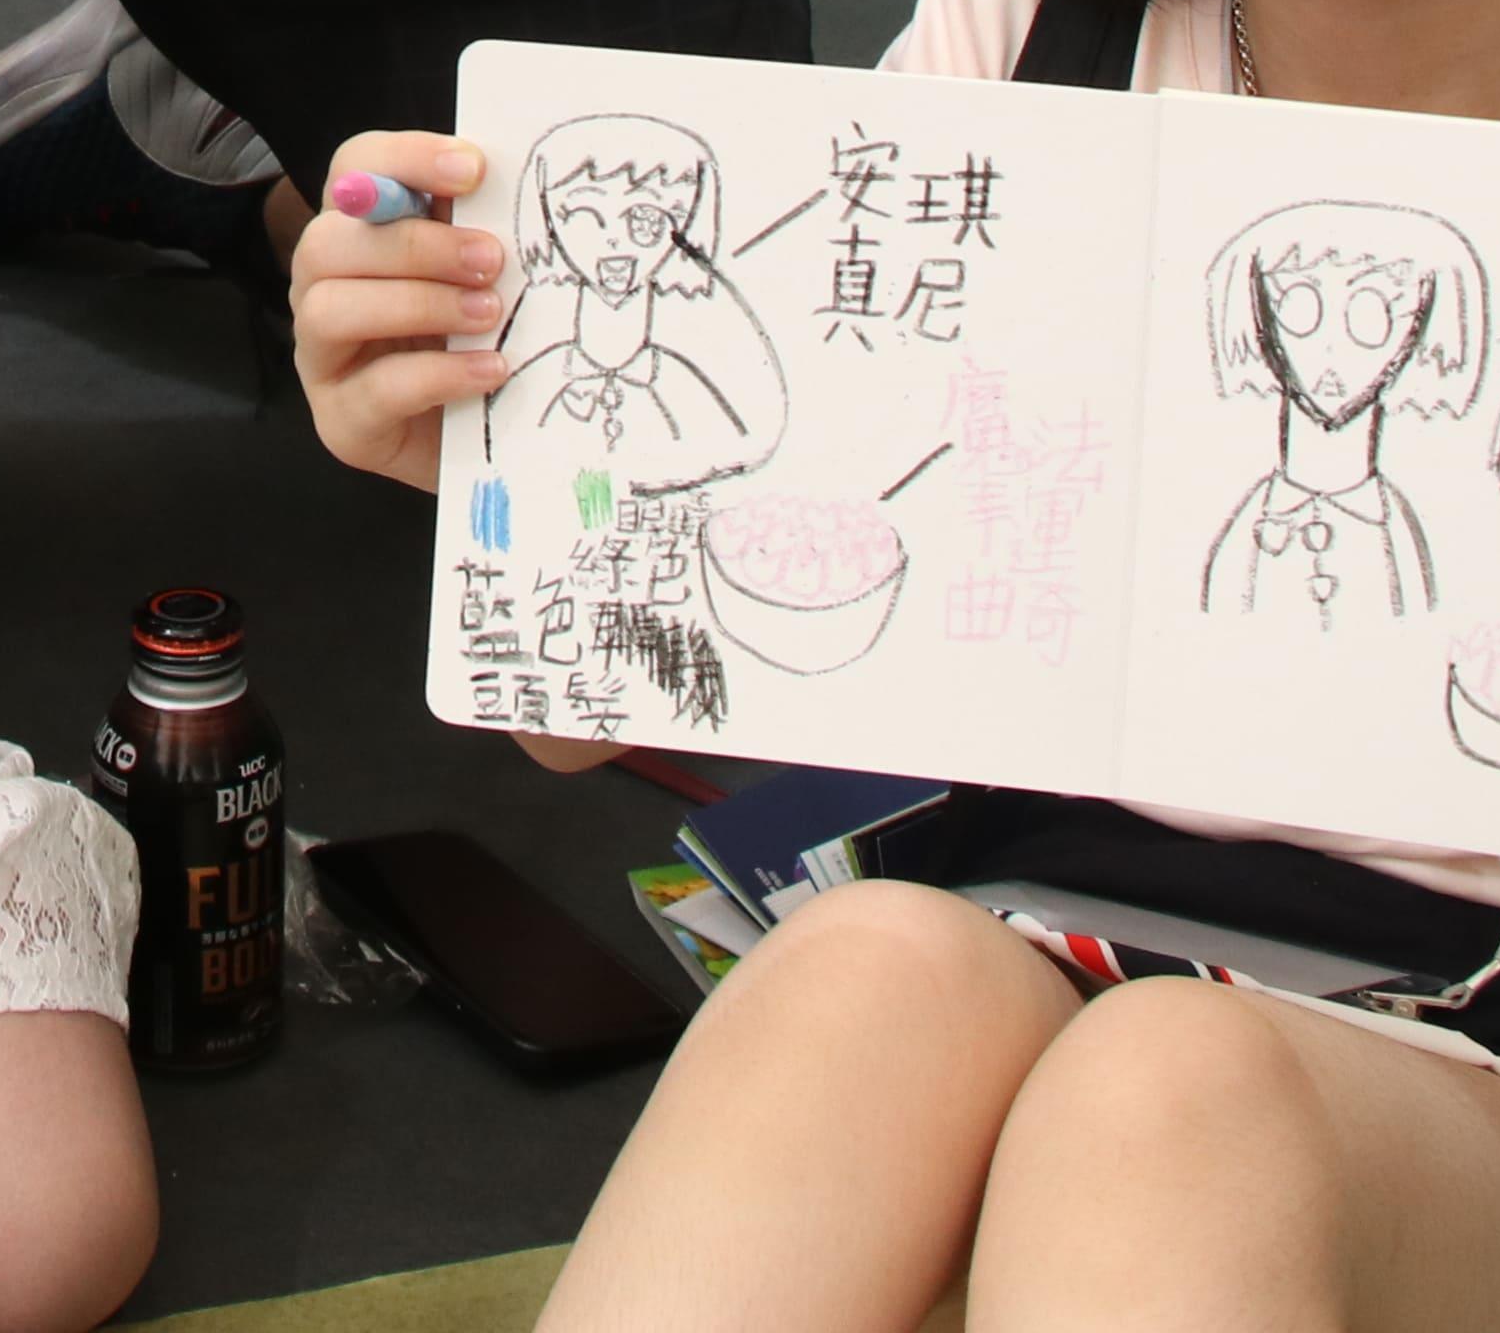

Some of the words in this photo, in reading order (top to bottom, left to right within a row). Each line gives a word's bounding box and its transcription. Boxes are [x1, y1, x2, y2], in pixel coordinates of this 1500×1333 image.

[829, 120, 1004, 249] 安琪
[812, 223, 966, 352] 真尼
[453, 557, 582, 667] 藍色
[470, 672, 629, 741] 頭髮
[216, 760, 282, 824] BLACK
